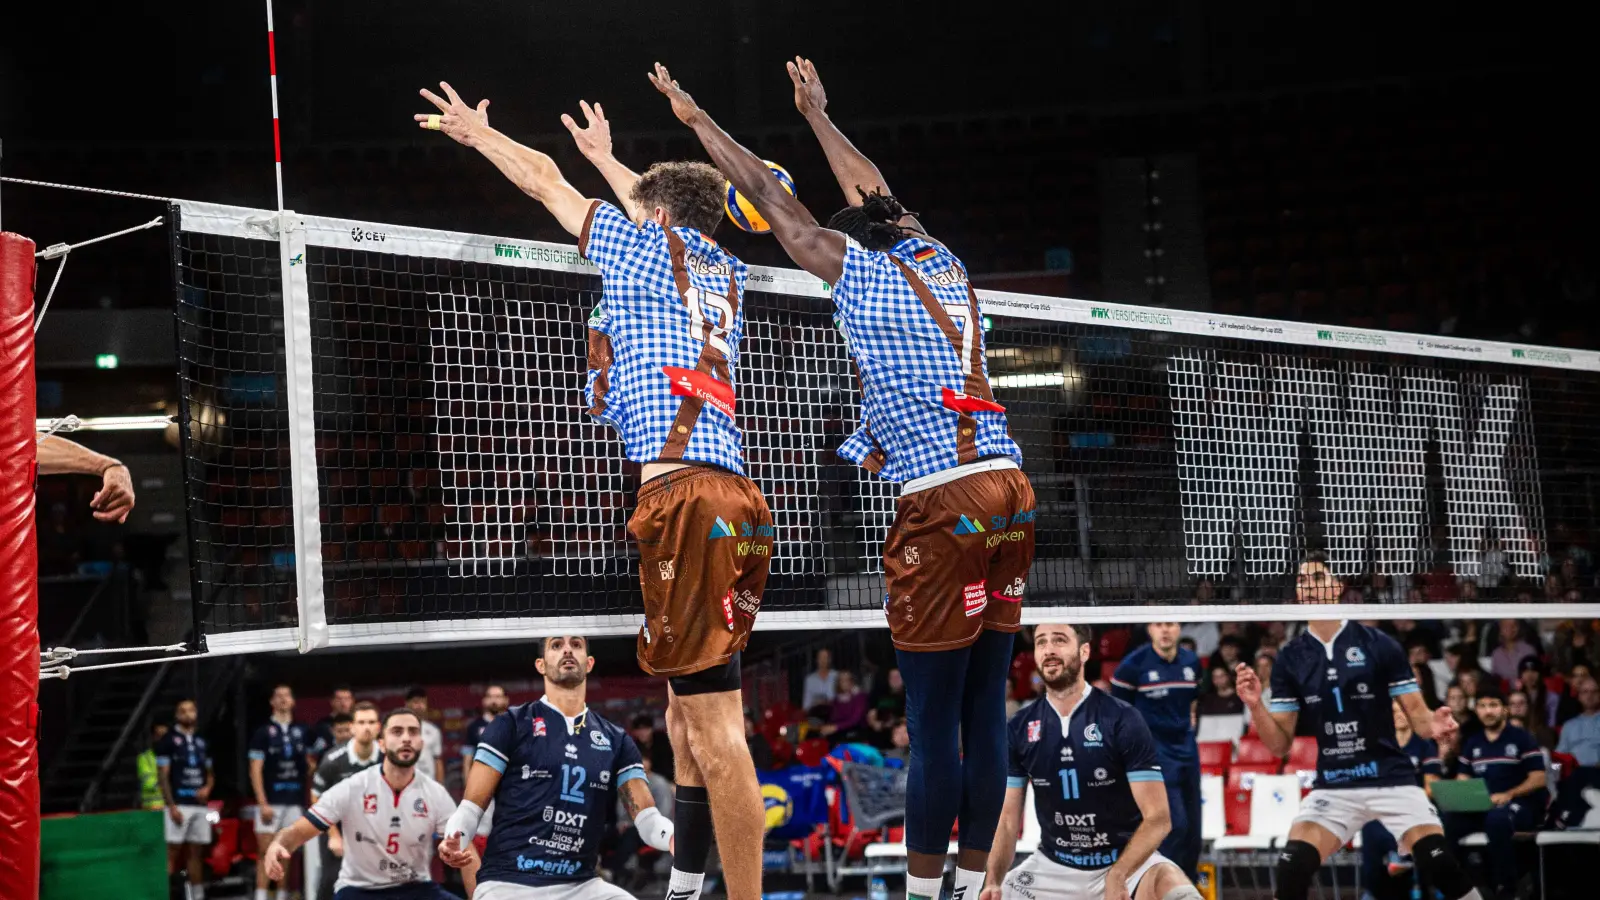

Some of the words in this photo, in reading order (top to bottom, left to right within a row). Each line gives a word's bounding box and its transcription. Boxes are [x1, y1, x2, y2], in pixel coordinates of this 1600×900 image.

[365, 231, 386, 242] CEV
[494, 243, 523, 259] WWK
[523, 246, 594, 267] VERSICHERUN
[749, 273, 761, 284] Cup
[761, 273, 774, 283] 2025
[683, 286, 735, 361] 12
[1091, 306, 1111, 319] WWK
[1110, 308, 1173, 326] VERSICHERUNGEN
[943, 303, 974, 375] 7
[1331, 686, 1344, 713] 1
[1334, 720, 1359, 735] DXT
[560, 764, 587, 799] 12
[1058, 768, 1080, 800] 11
[554, 810, 588, 828] DXT
[1064, 813, 1097, 826] DXT
[551, 832, 573, 844] Islas
[553, 824, 582, 836] TENERIFE
[1070, 833, 1091, 841] Islas
[386, 832, 400, 855] 5
[528, 836, 571, 852] Canarias
[1056, 837, 1093, 848] Canarias
